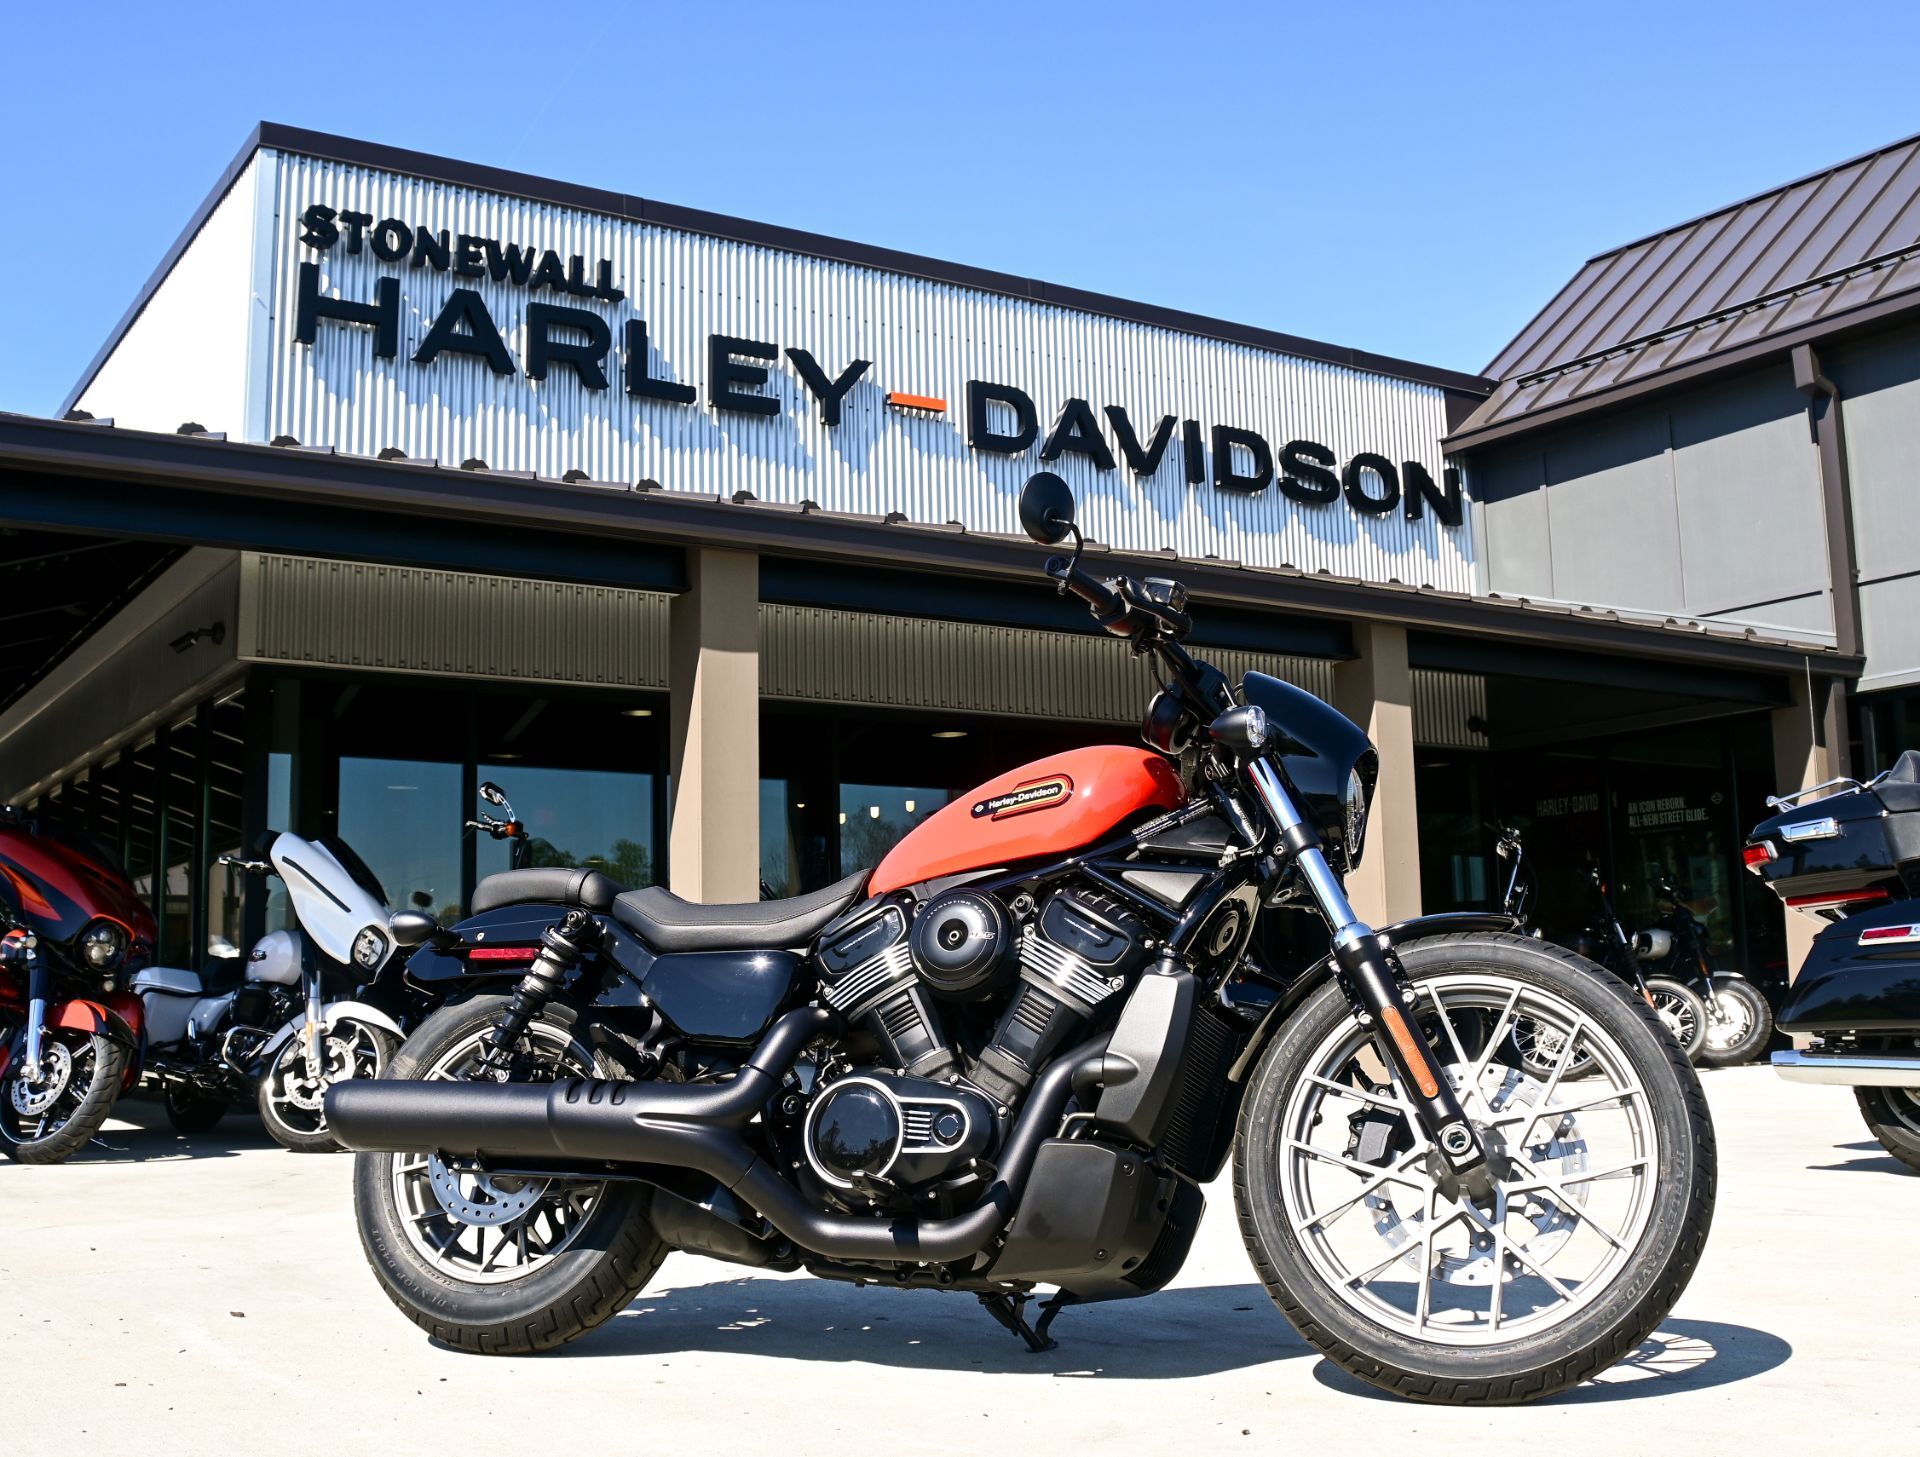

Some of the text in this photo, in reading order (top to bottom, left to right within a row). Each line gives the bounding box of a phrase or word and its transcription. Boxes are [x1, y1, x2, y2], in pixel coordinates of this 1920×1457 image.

[299, 203, 626, 303] STONEWALL
[293, 262, 1464, 528] HARLEY-DAVIDSON
[988, 786, 1060, 810] Harley-Davidson
[1628, 795, 1687, 815] AN ICON REBORN.
[1629, 807, 1709, 828] ALL-NEW STREET GLIDE.
